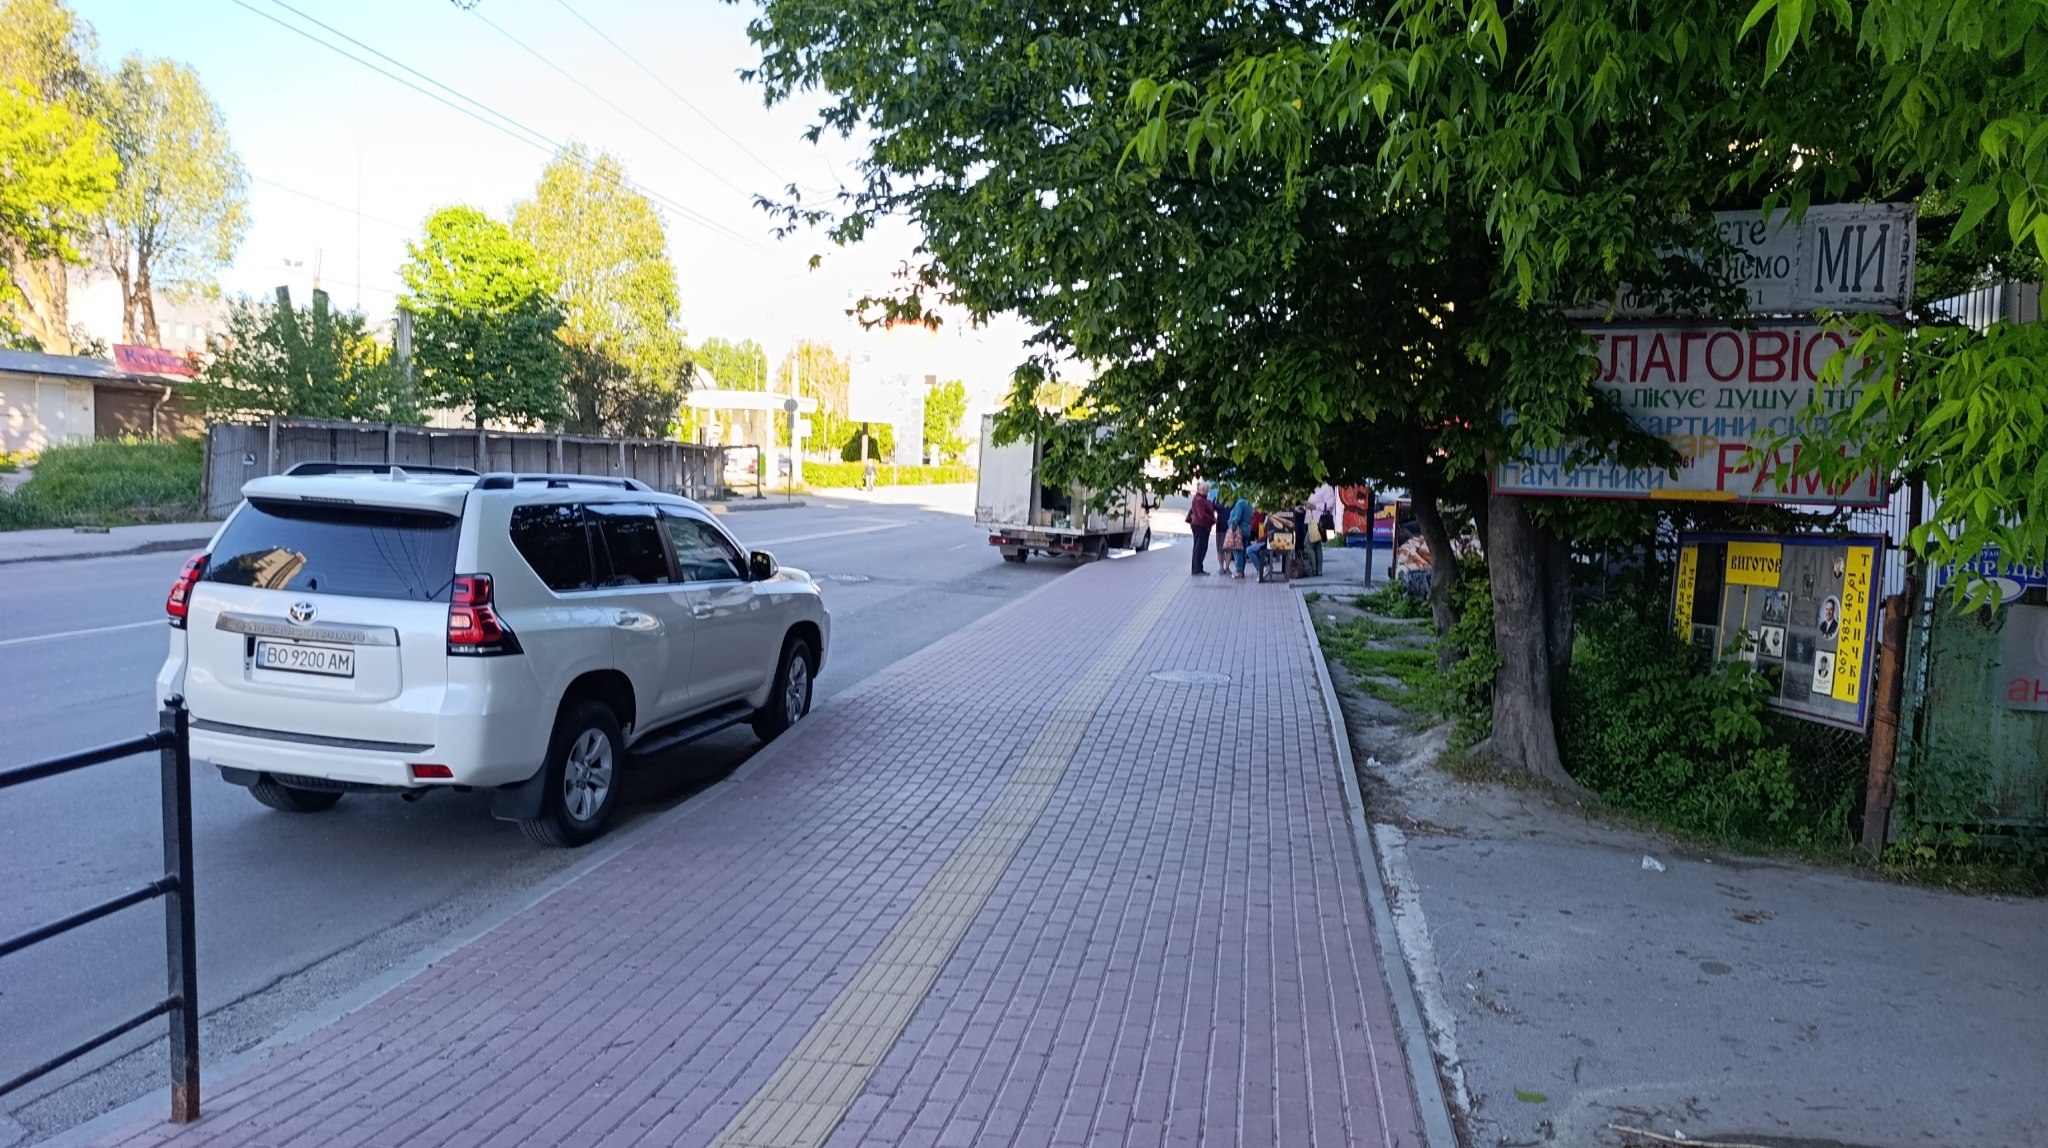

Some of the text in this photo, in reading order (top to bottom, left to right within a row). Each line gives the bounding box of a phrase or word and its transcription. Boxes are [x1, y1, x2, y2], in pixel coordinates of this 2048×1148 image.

[1814, 223, 1891, 294] МИ
[1845, 592, 1854, 612] 40
[1841, 617, 1852, 643] 582
[267, 647, 350, 672] BO 9200 AM
[1837, 648, 1850, 675] 067
